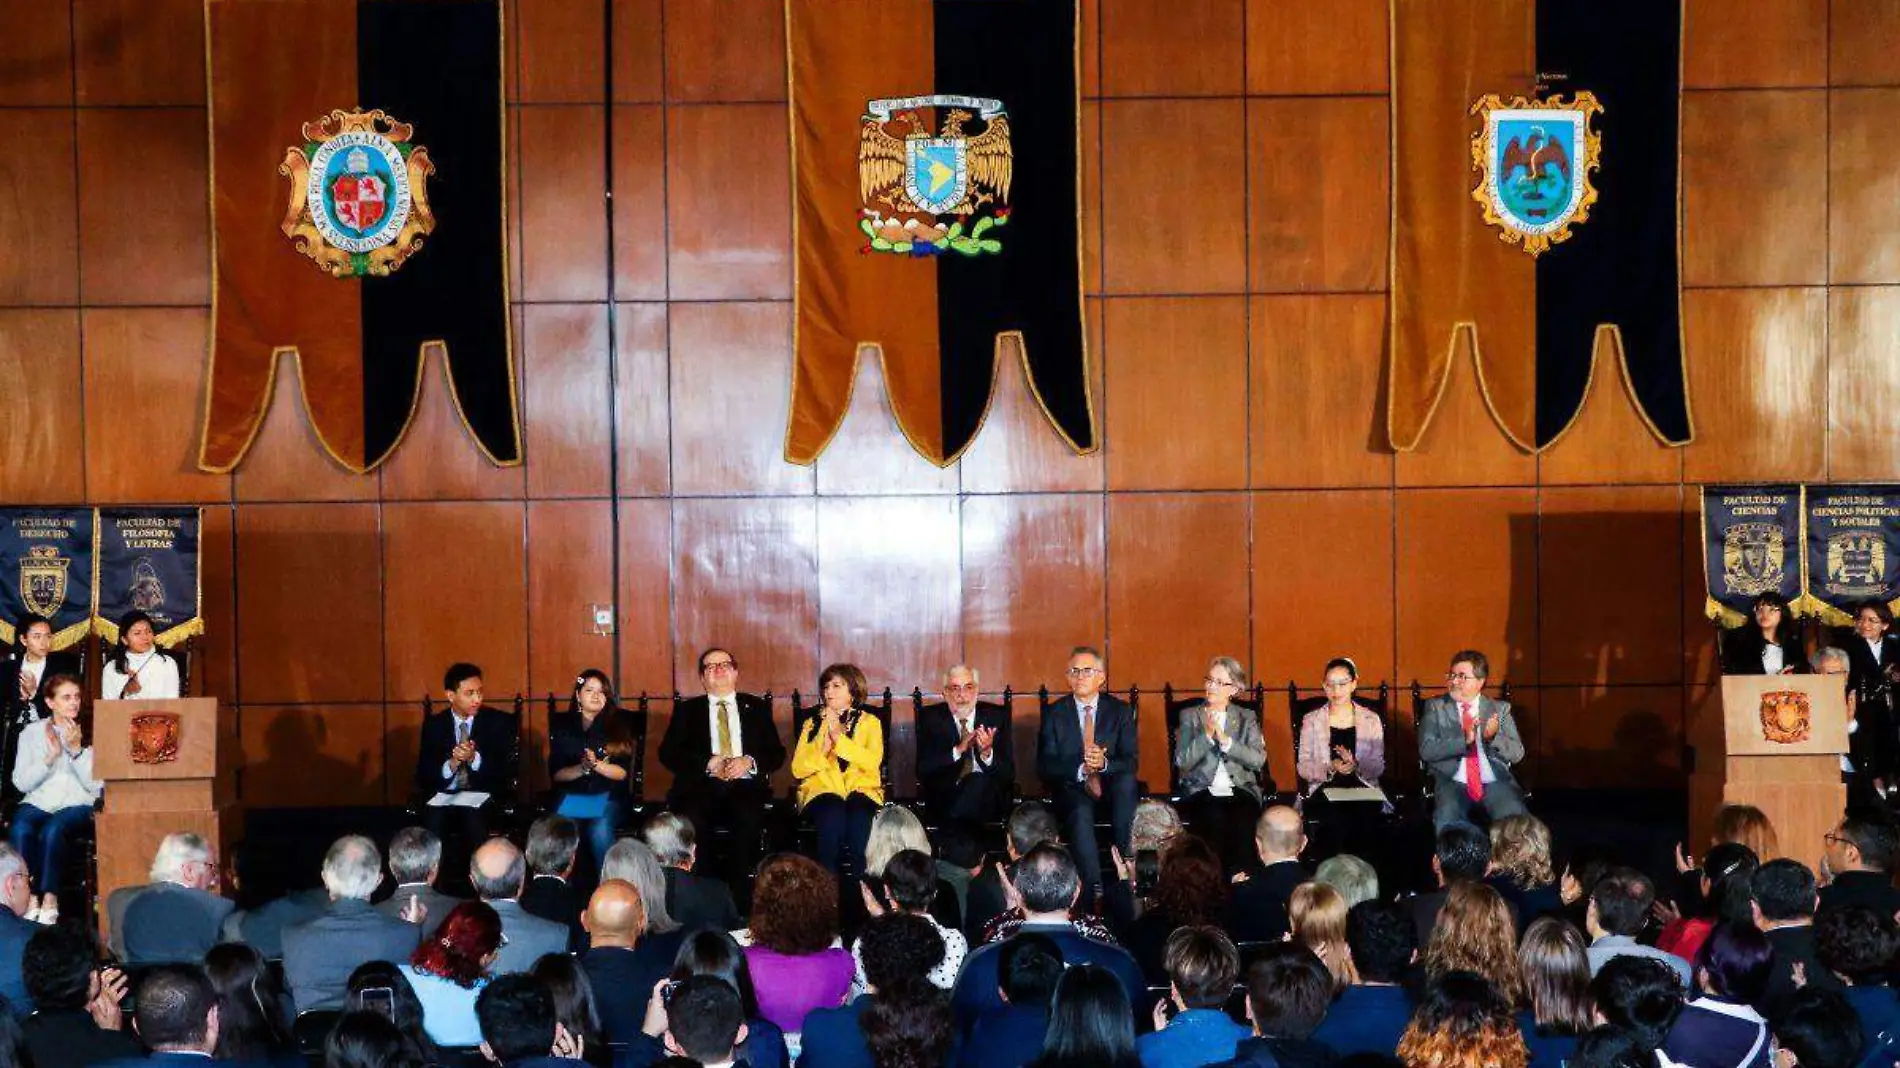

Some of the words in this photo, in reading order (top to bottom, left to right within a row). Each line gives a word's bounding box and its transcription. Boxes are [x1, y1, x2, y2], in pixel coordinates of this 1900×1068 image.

[1724, 496, 1770, 505] FACULTAD
[1773, 496, 1787, 504] DE
[1828, 496, 1870, 505] FACULTAD
[1872, 496, 1884, 504] DE
[1732, 507, 1777, 515] CIENCIAS
[1812, 507, 1854, 516] CIENCIAS
[12, 518, 60, 527] FACULTAD
[63, 518, 76, 527] DE
[116, 518, 165, 528] FACULTAD
[167, 518, 181, 527] DE
[1832, 518, 1838, 527] Y
[1841, 518, 1880, 526] SOCIALES
[20, 530, 69, 538] DERECHO
[125, 540, 131, 548] Y
[134, 540, 173, 548] LETRAS
